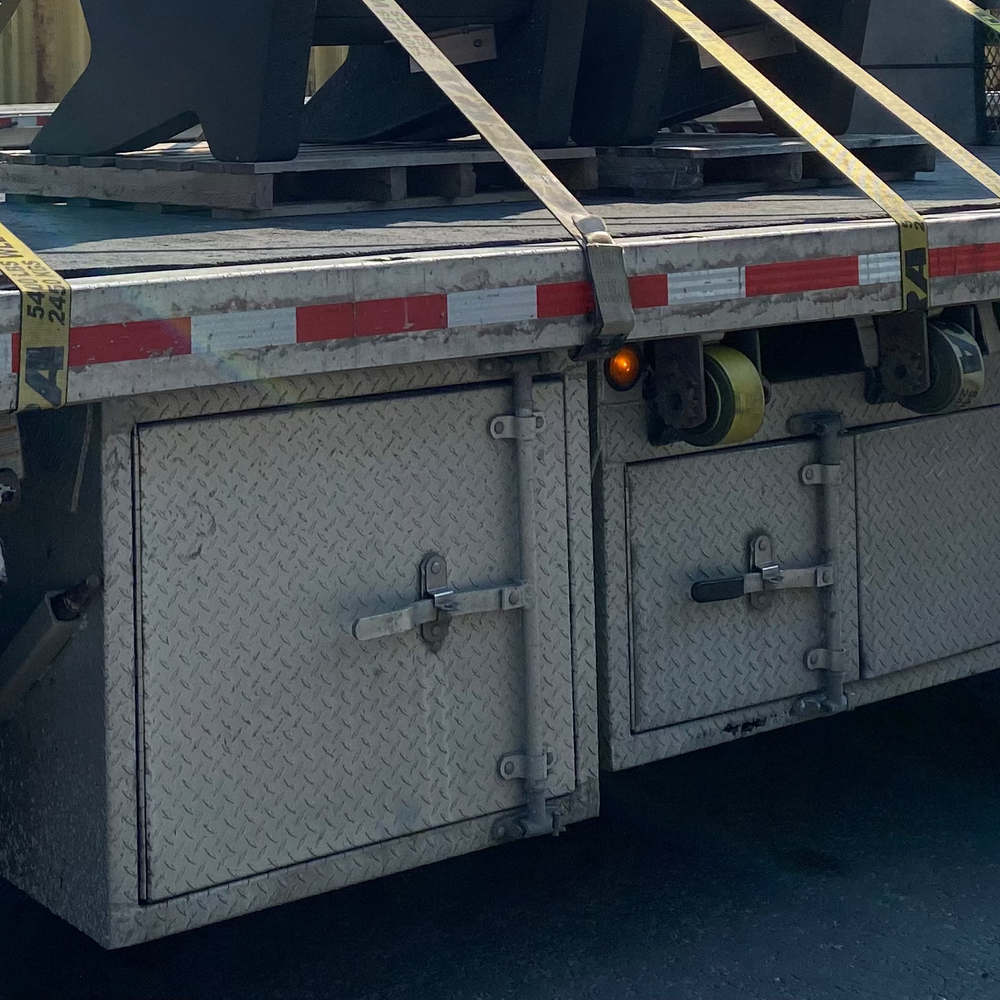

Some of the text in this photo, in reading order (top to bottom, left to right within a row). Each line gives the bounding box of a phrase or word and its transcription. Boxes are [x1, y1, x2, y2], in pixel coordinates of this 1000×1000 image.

[0, 261, 31, 277] LBS
[18, 279, 45, 319] 5400
[22, 260, 66, 326] 2450 KGS
